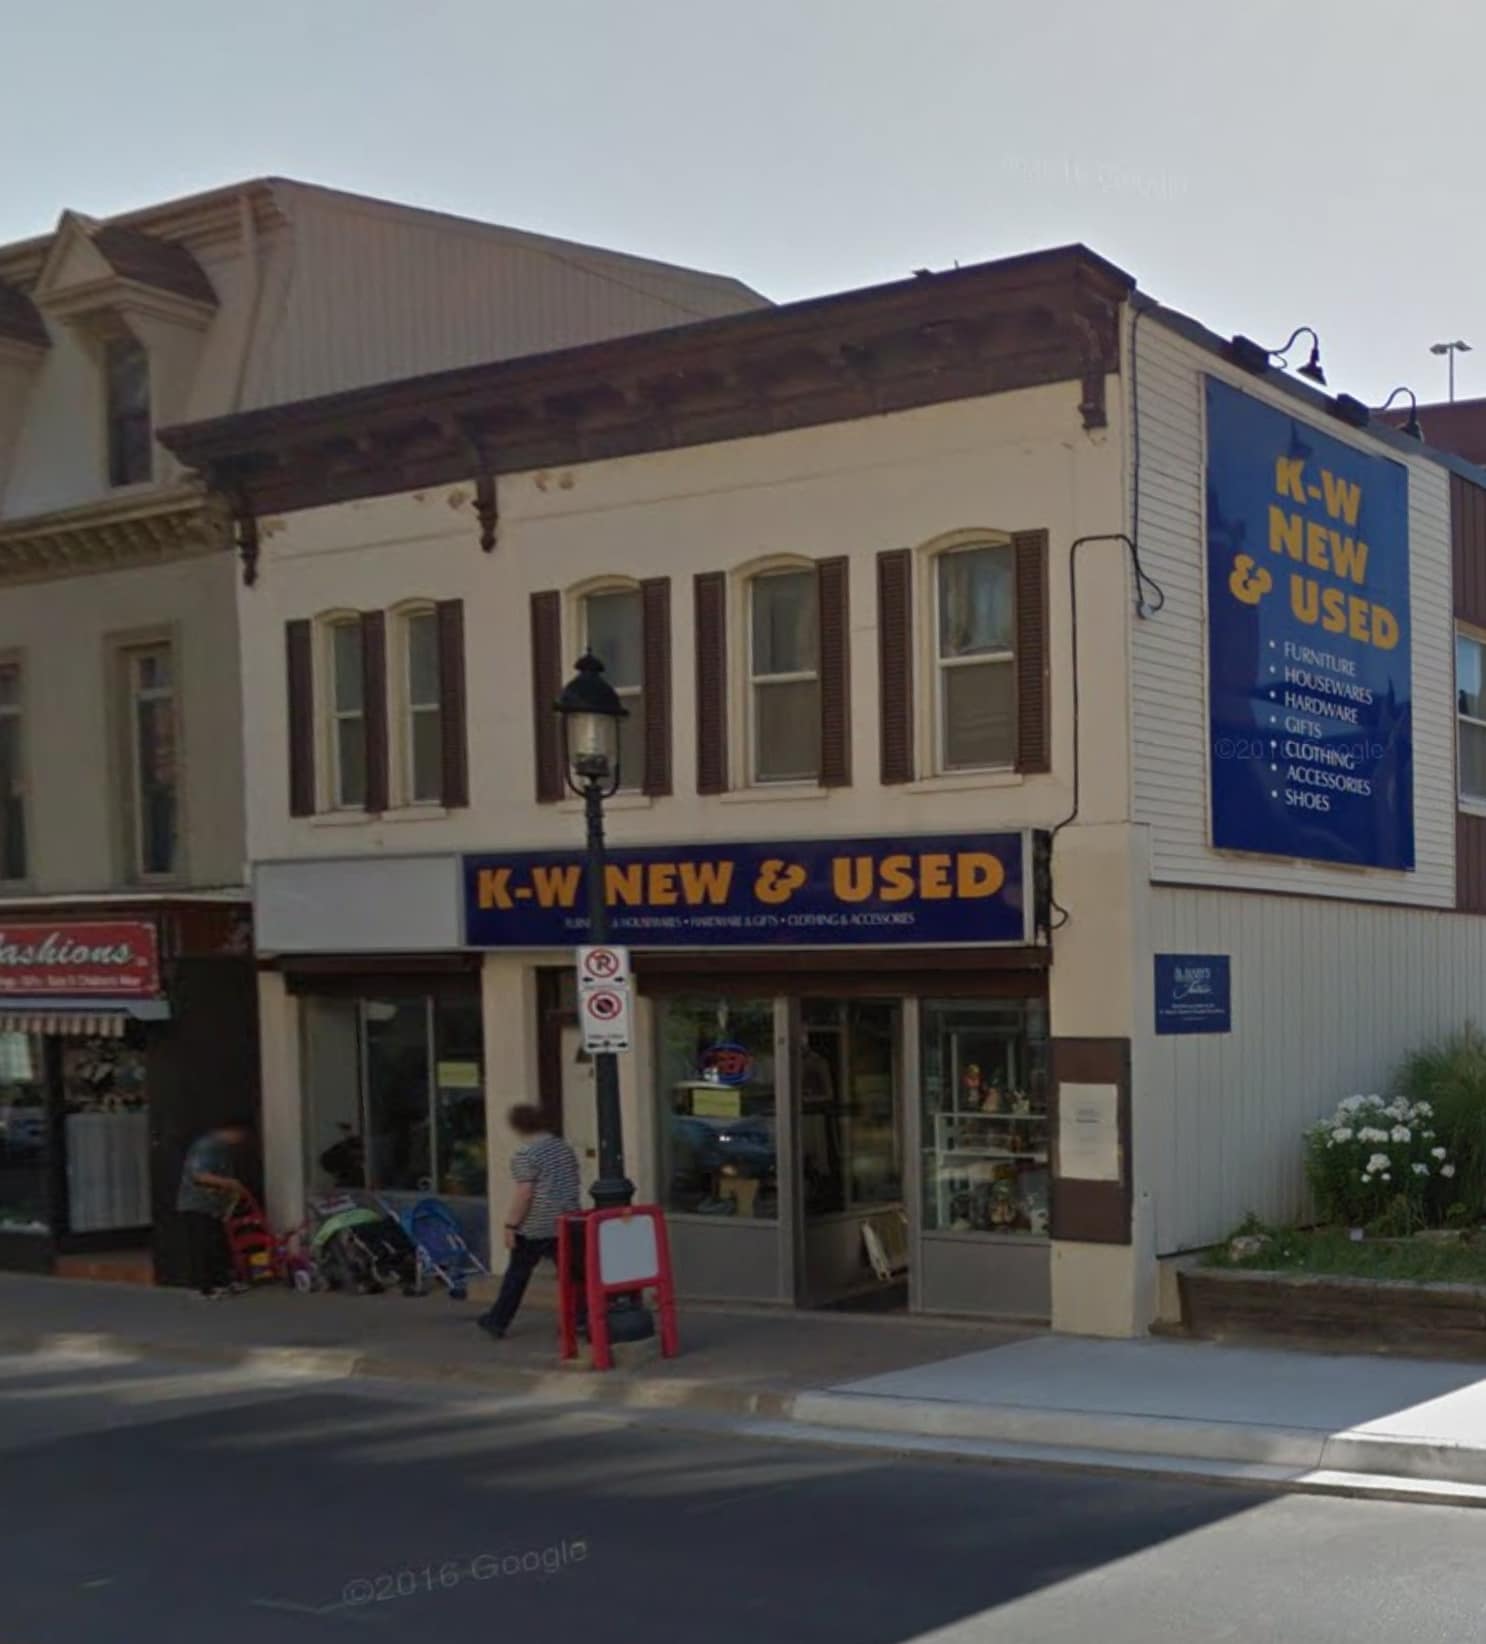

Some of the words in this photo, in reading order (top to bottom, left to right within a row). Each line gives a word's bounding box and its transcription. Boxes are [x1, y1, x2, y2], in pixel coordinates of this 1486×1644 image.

[1275, 456, 1362, 526] K-W
[1268, 504, 1369, 585] NEW
[1230, 553, 1272, 605] &
[1290, 573, 1400, 651] USED
[1283, 641, 1357, 677] FURNITURE
[1284, 665, 1373, 706] HOUSEWARES
[1284, 691, 1359, 725] HARDWARE
[1284, 716, 1323, 739] GIFTS
[1285, 740, 1356, 770] CLOTHING
[1286, 766, 1372, 796] ACCESSORIES
[1285, 789, 1331, 812] SHOES
[477, 865, 582, 909] K-W
[604, 861, 734, 906] NEW
[754, 859, 807, 904] &
[831, 852, 1005, 902] USED
